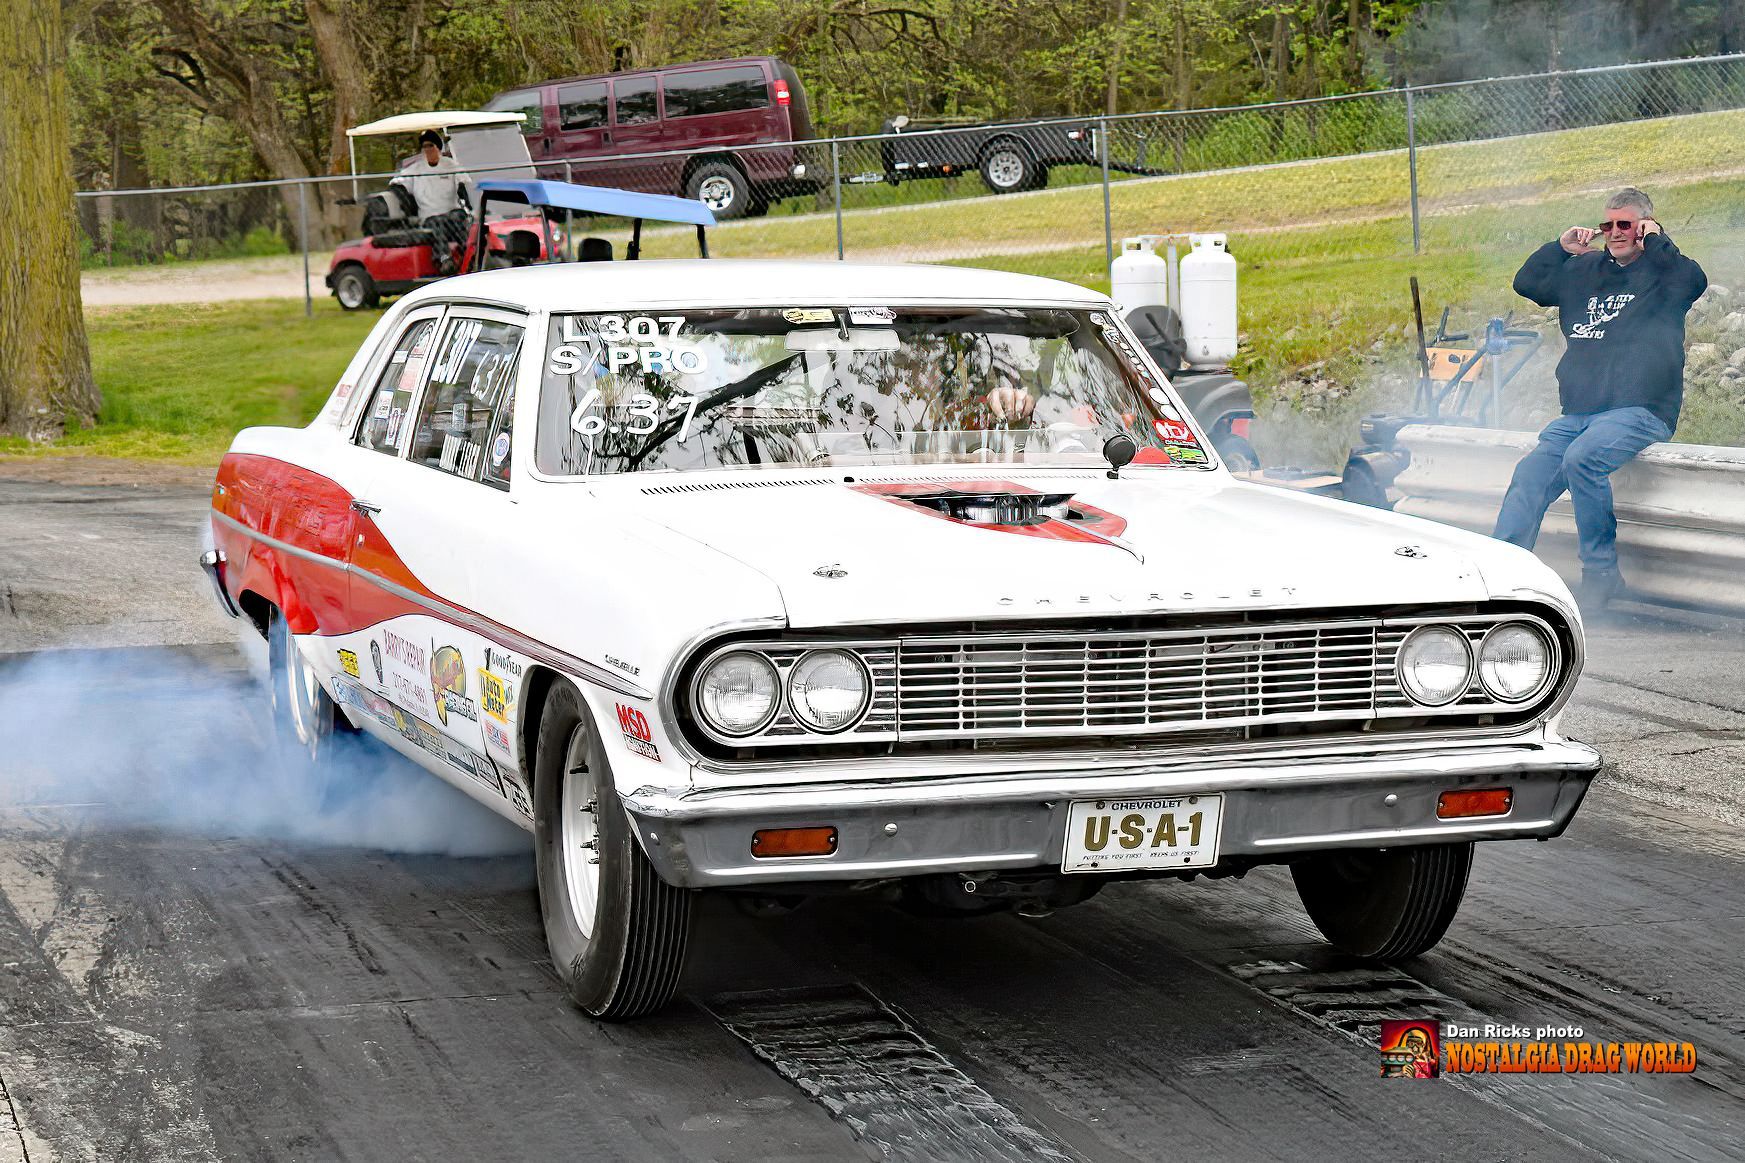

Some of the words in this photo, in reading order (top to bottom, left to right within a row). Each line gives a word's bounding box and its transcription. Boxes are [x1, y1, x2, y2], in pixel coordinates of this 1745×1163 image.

[563, 316, 686, 343] L307
[550, 346, 708, 375] S/PRO
[571, 389, 699, 443] 6.37
[491, 652, 522, 678] GOODYEAR
[615, 702, 652, 742] MSD
[1111, 799, 1183, 811] CHEVROLET
[1084, 812, 1203, 852] U-S-A-1
